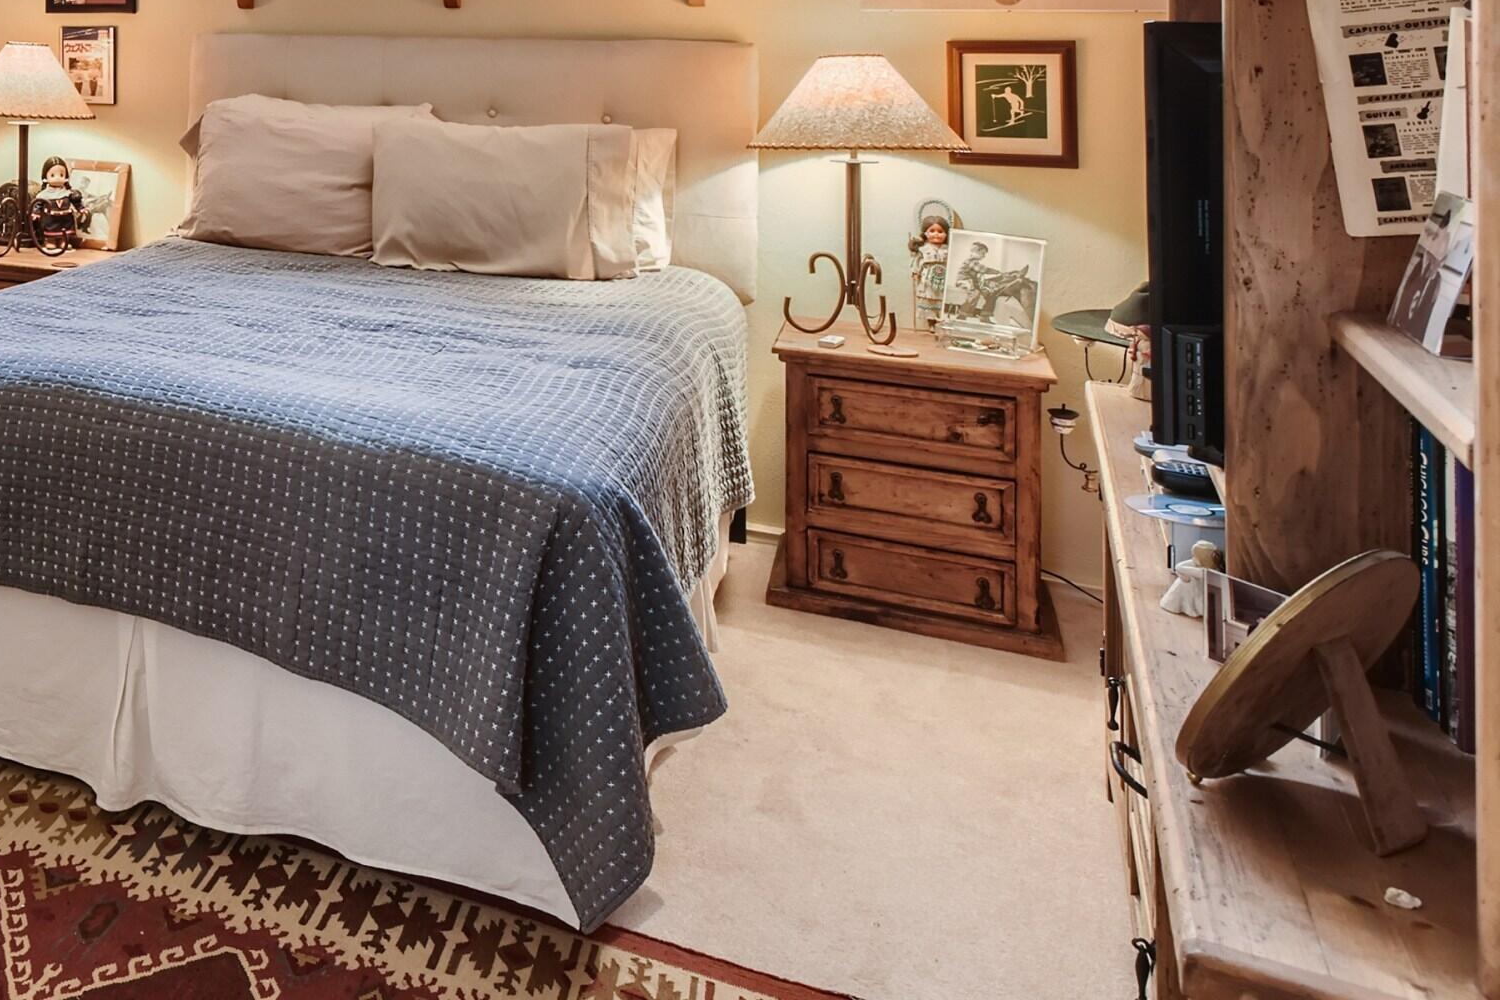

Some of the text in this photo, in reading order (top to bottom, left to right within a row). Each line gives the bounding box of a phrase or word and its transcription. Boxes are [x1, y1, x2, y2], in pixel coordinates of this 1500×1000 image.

[1348, 24, 1401, 35] CAPITOL'S
[1367, 92, 1413, 102] CAPITOL
[1365, 110, 1402, 119] GUITAR
[1382, 215, 1418, 224] CAPITOL
